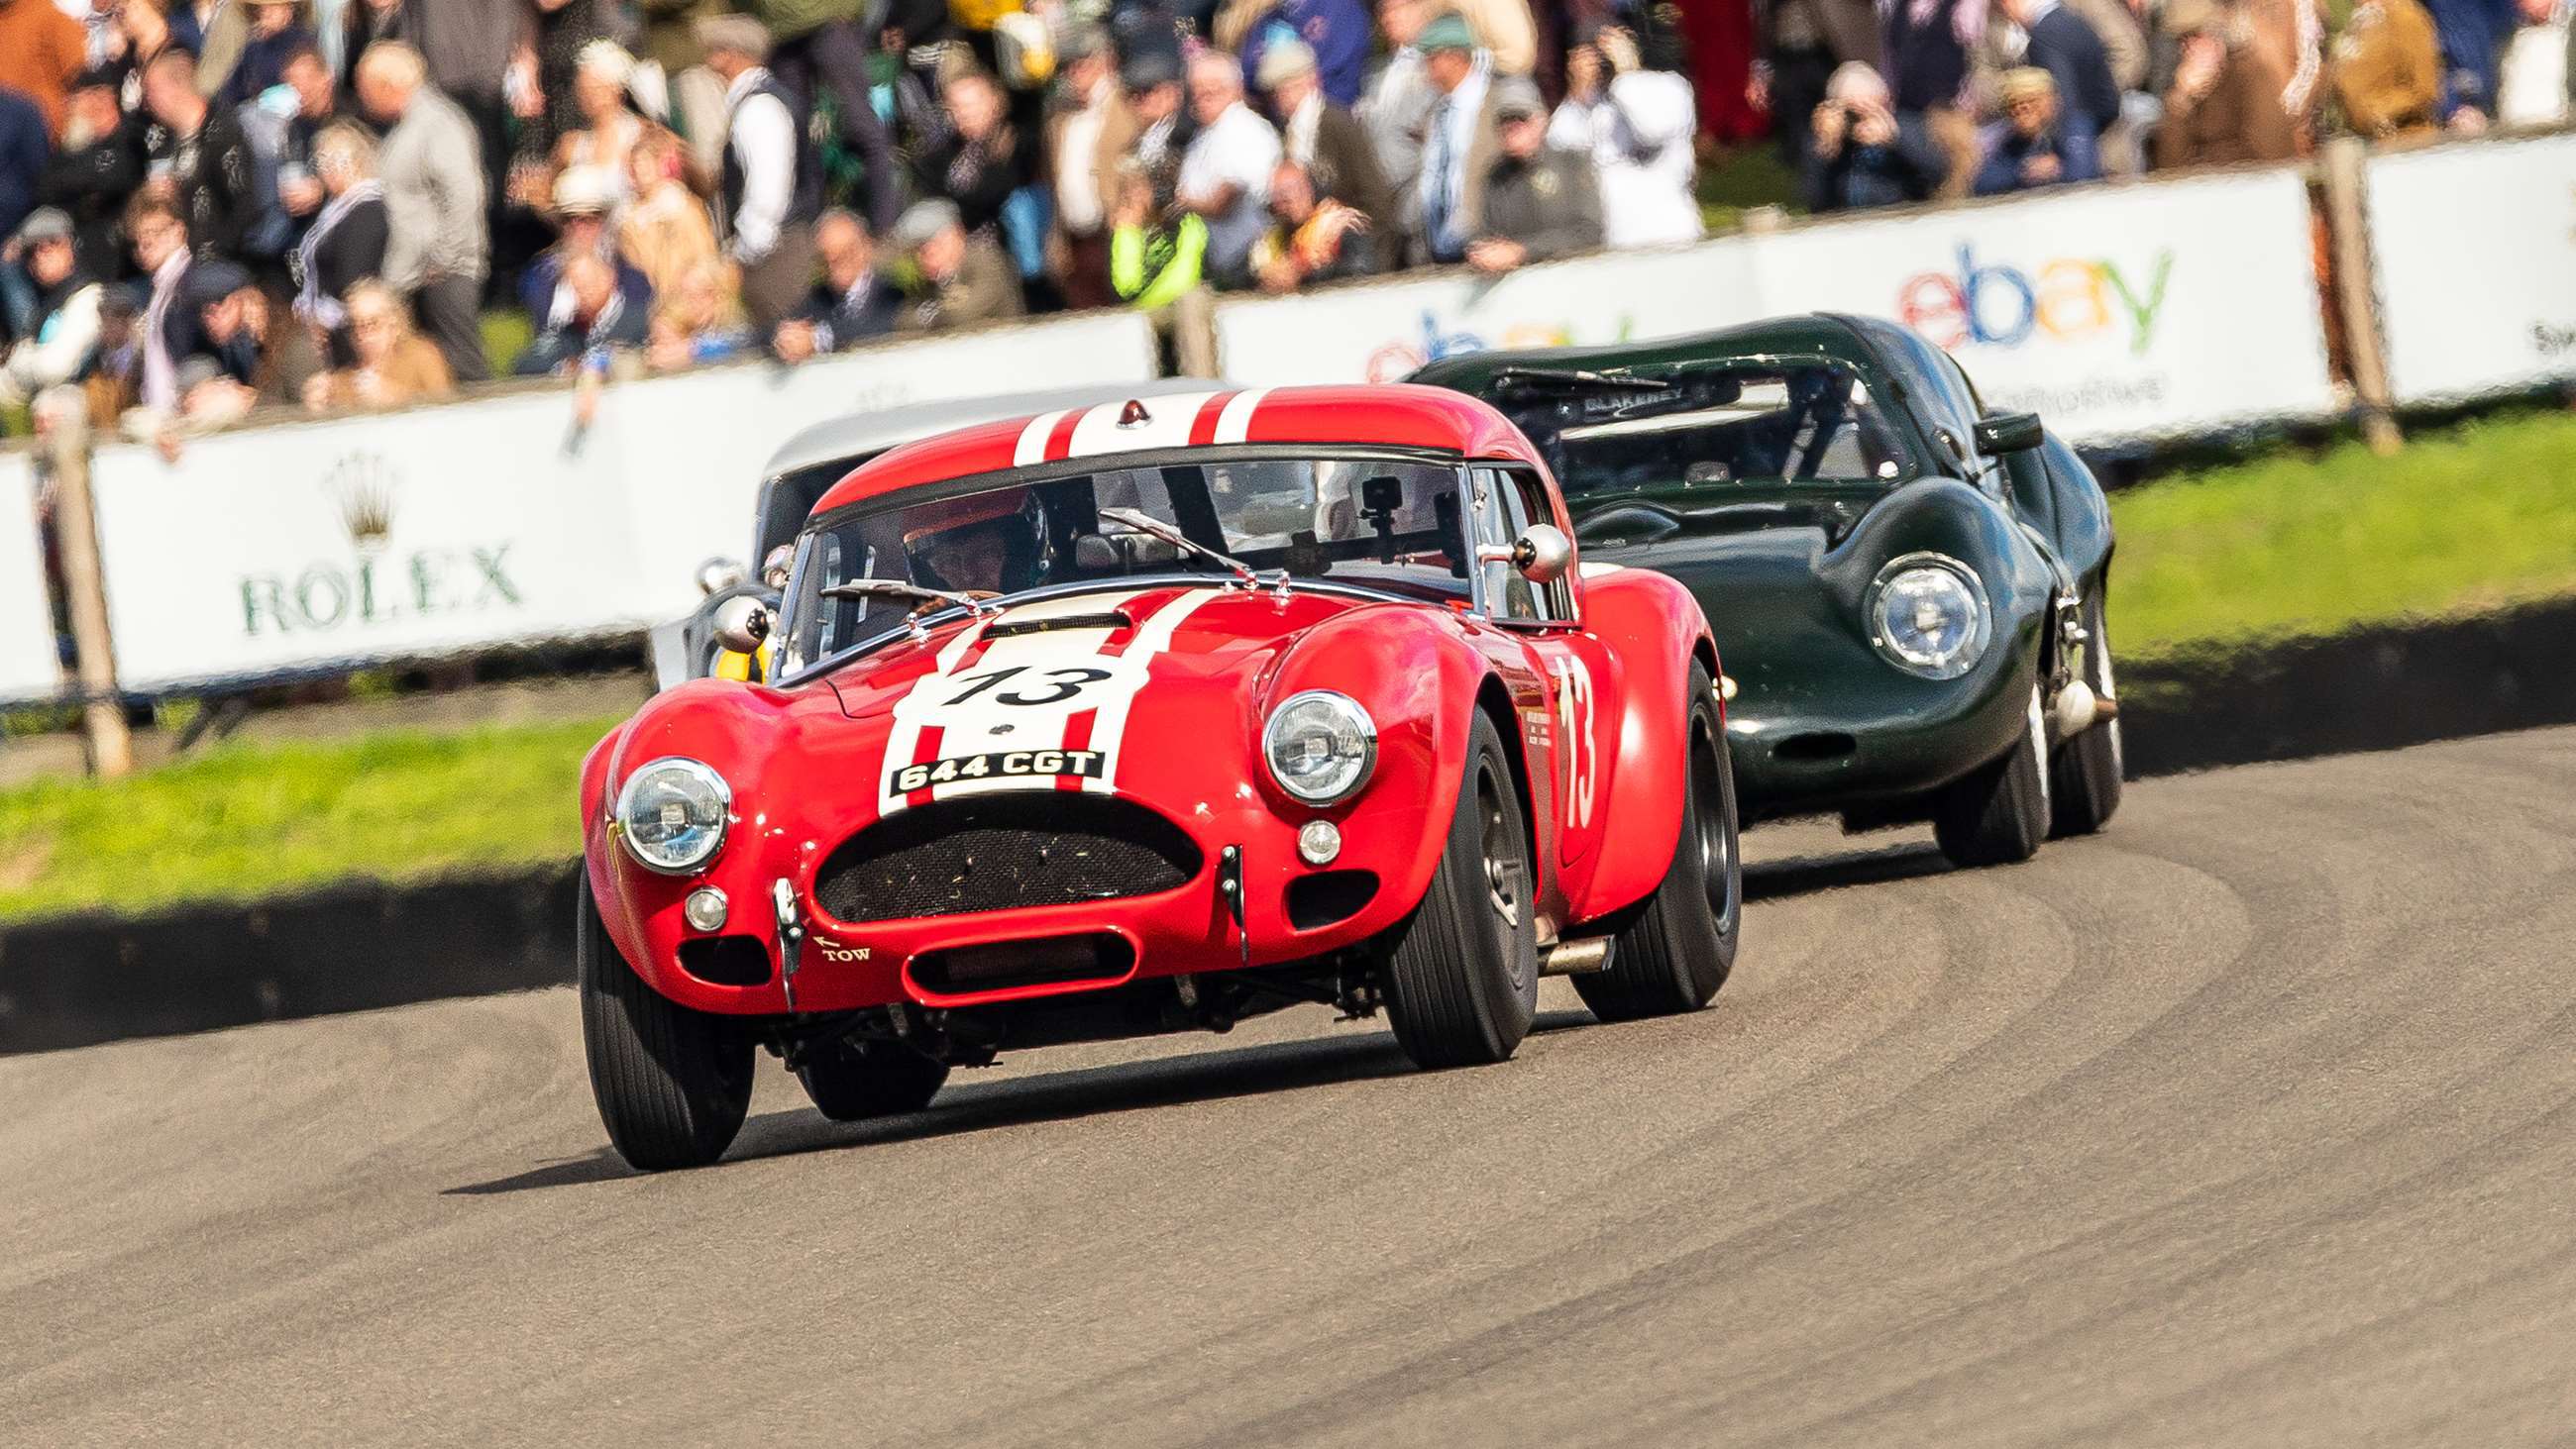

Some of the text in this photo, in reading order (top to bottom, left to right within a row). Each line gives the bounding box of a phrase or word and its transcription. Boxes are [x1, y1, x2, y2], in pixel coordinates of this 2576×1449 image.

[1898, 242, 2173, 356] ebay
[239, 541, 520, 635] ROLEX
[940, 666, 1113, 706] 13
[898, 750, 1097, 790] 644 CGT
[1555, 654, 1596, 829] 13
[821, 947, 871, 963] TOW
